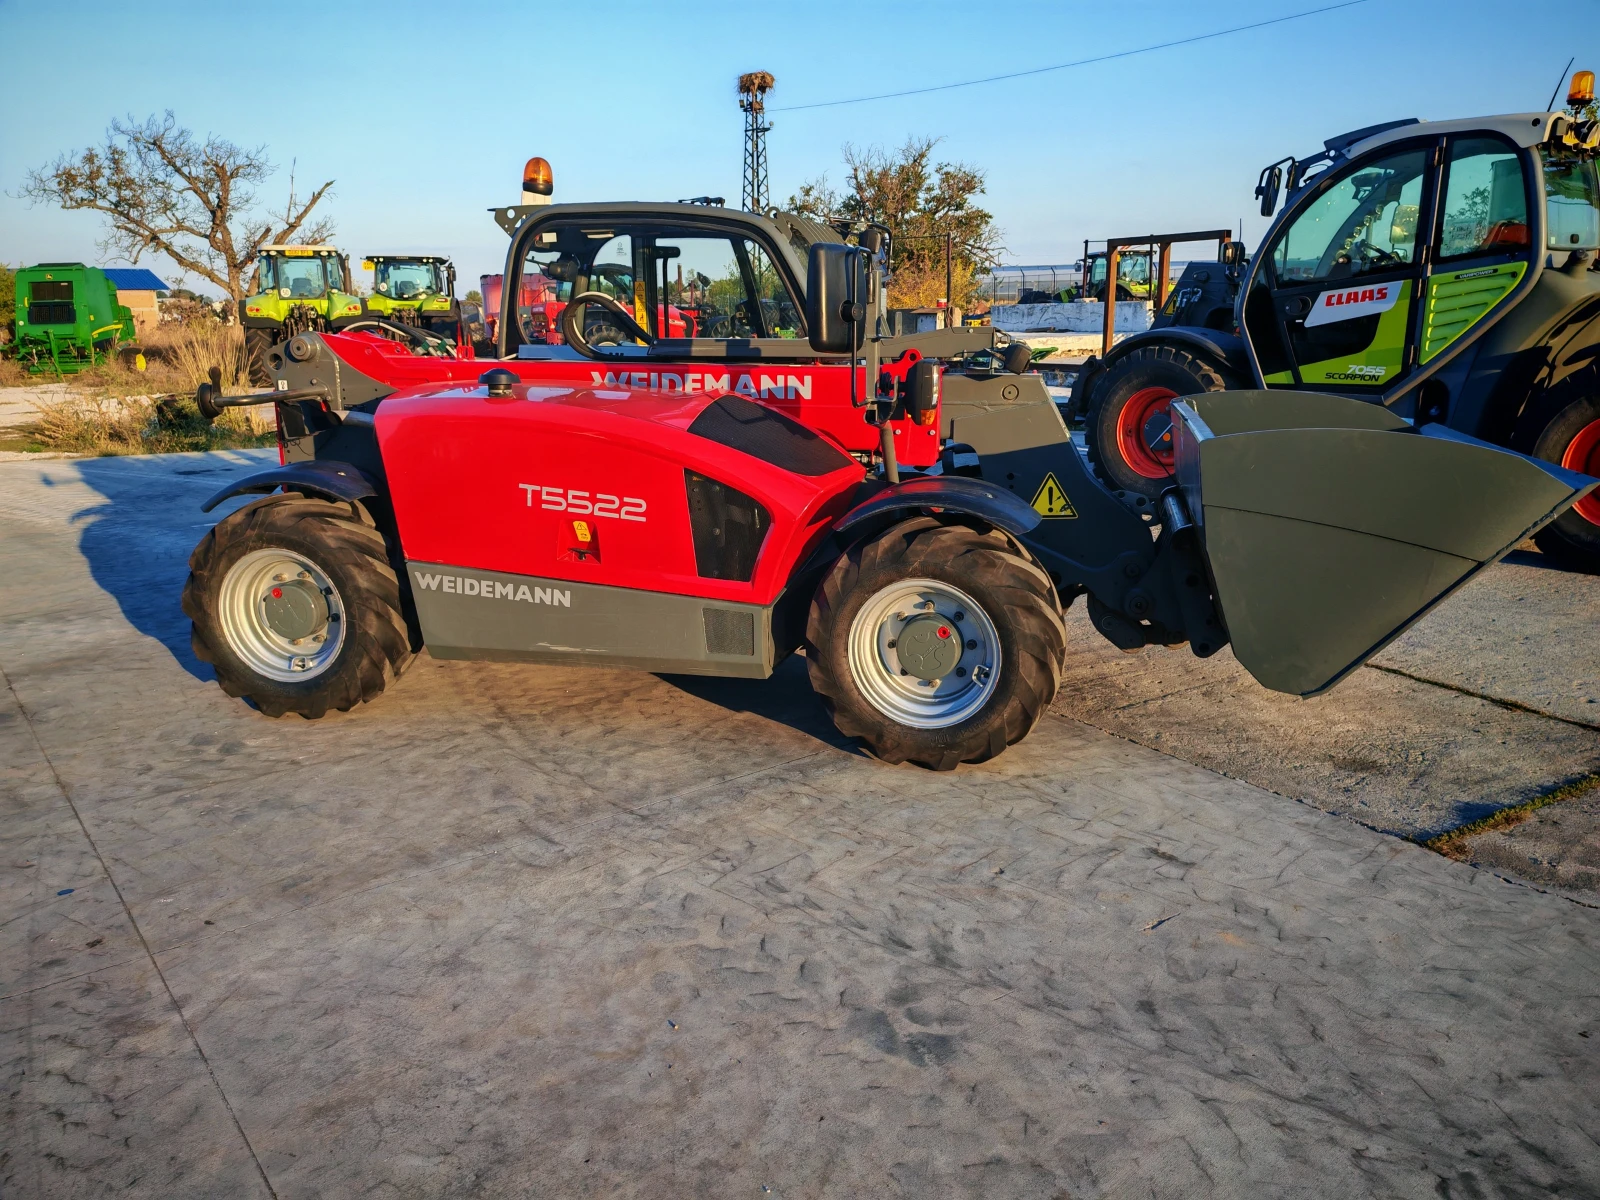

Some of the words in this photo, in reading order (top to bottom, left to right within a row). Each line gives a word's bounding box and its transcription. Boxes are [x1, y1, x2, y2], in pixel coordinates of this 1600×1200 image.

[1325, 287, 1388, 307] CLAAS
[1325, 373, 1380, 382] SCORPION
[1347, 365, 1386, 376] 7055
[519, 483, 646, 522] T5522
[415, 572, 571, 608] WEIDEMANN
